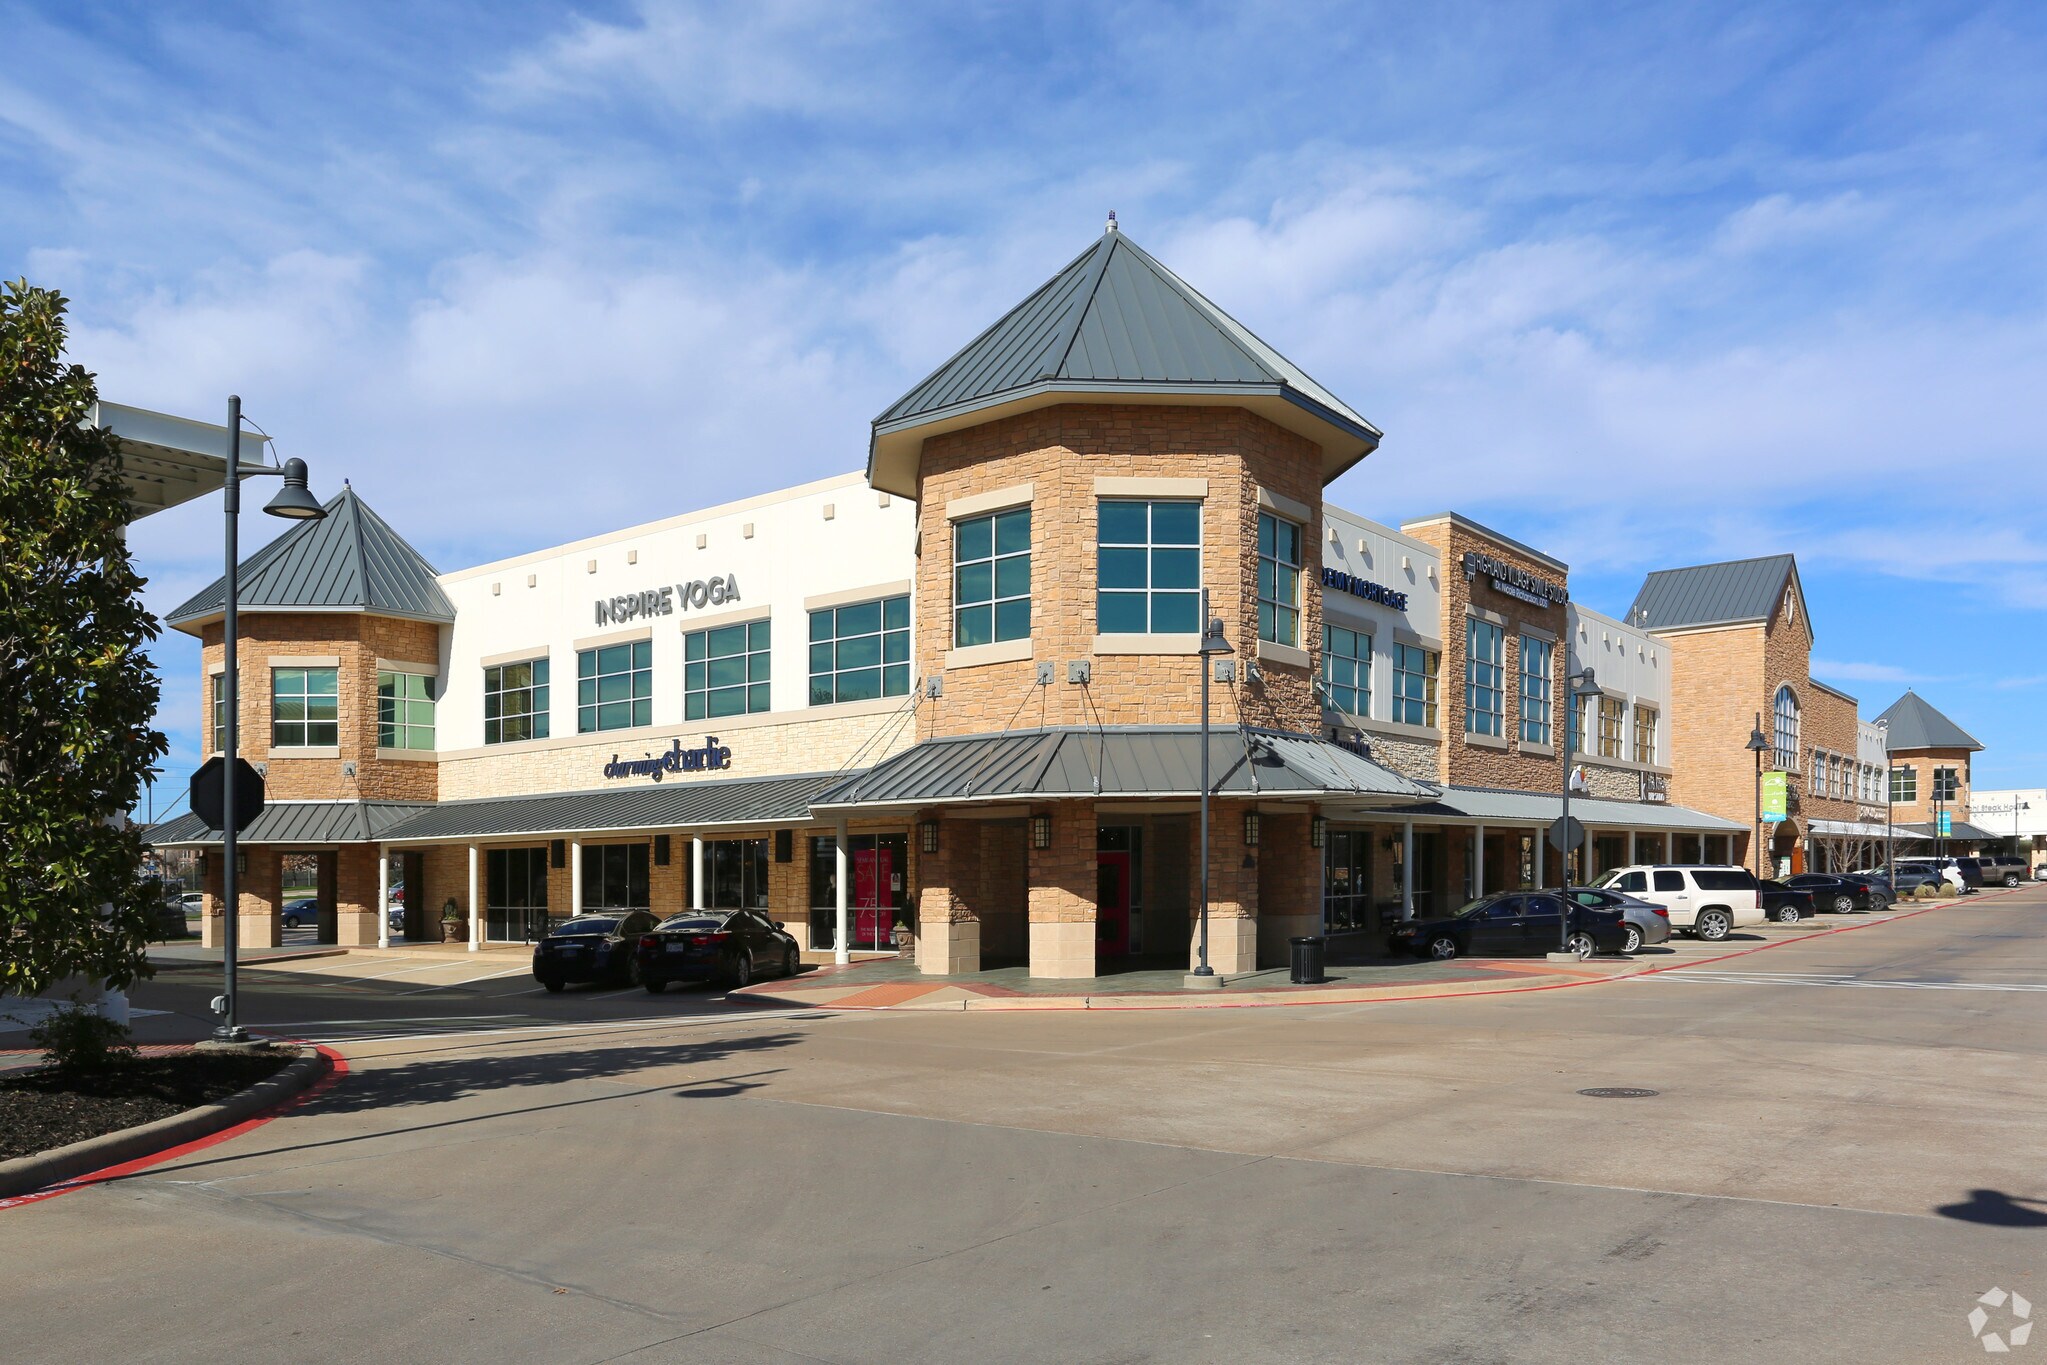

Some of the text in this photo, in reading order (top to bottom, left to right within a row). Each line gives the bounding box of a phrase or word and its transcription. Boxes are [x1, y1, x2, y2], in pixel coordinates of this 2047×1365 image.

[595, 573, 741, 627] INSPIRE YOGA
[1350, 576, 1408, 612] MORTGAGE
[1476, 553, 1569, 607] HIGHLAND VILLAGE SMILE STUDIO
[604, 736, 731, 782] charming charlie
